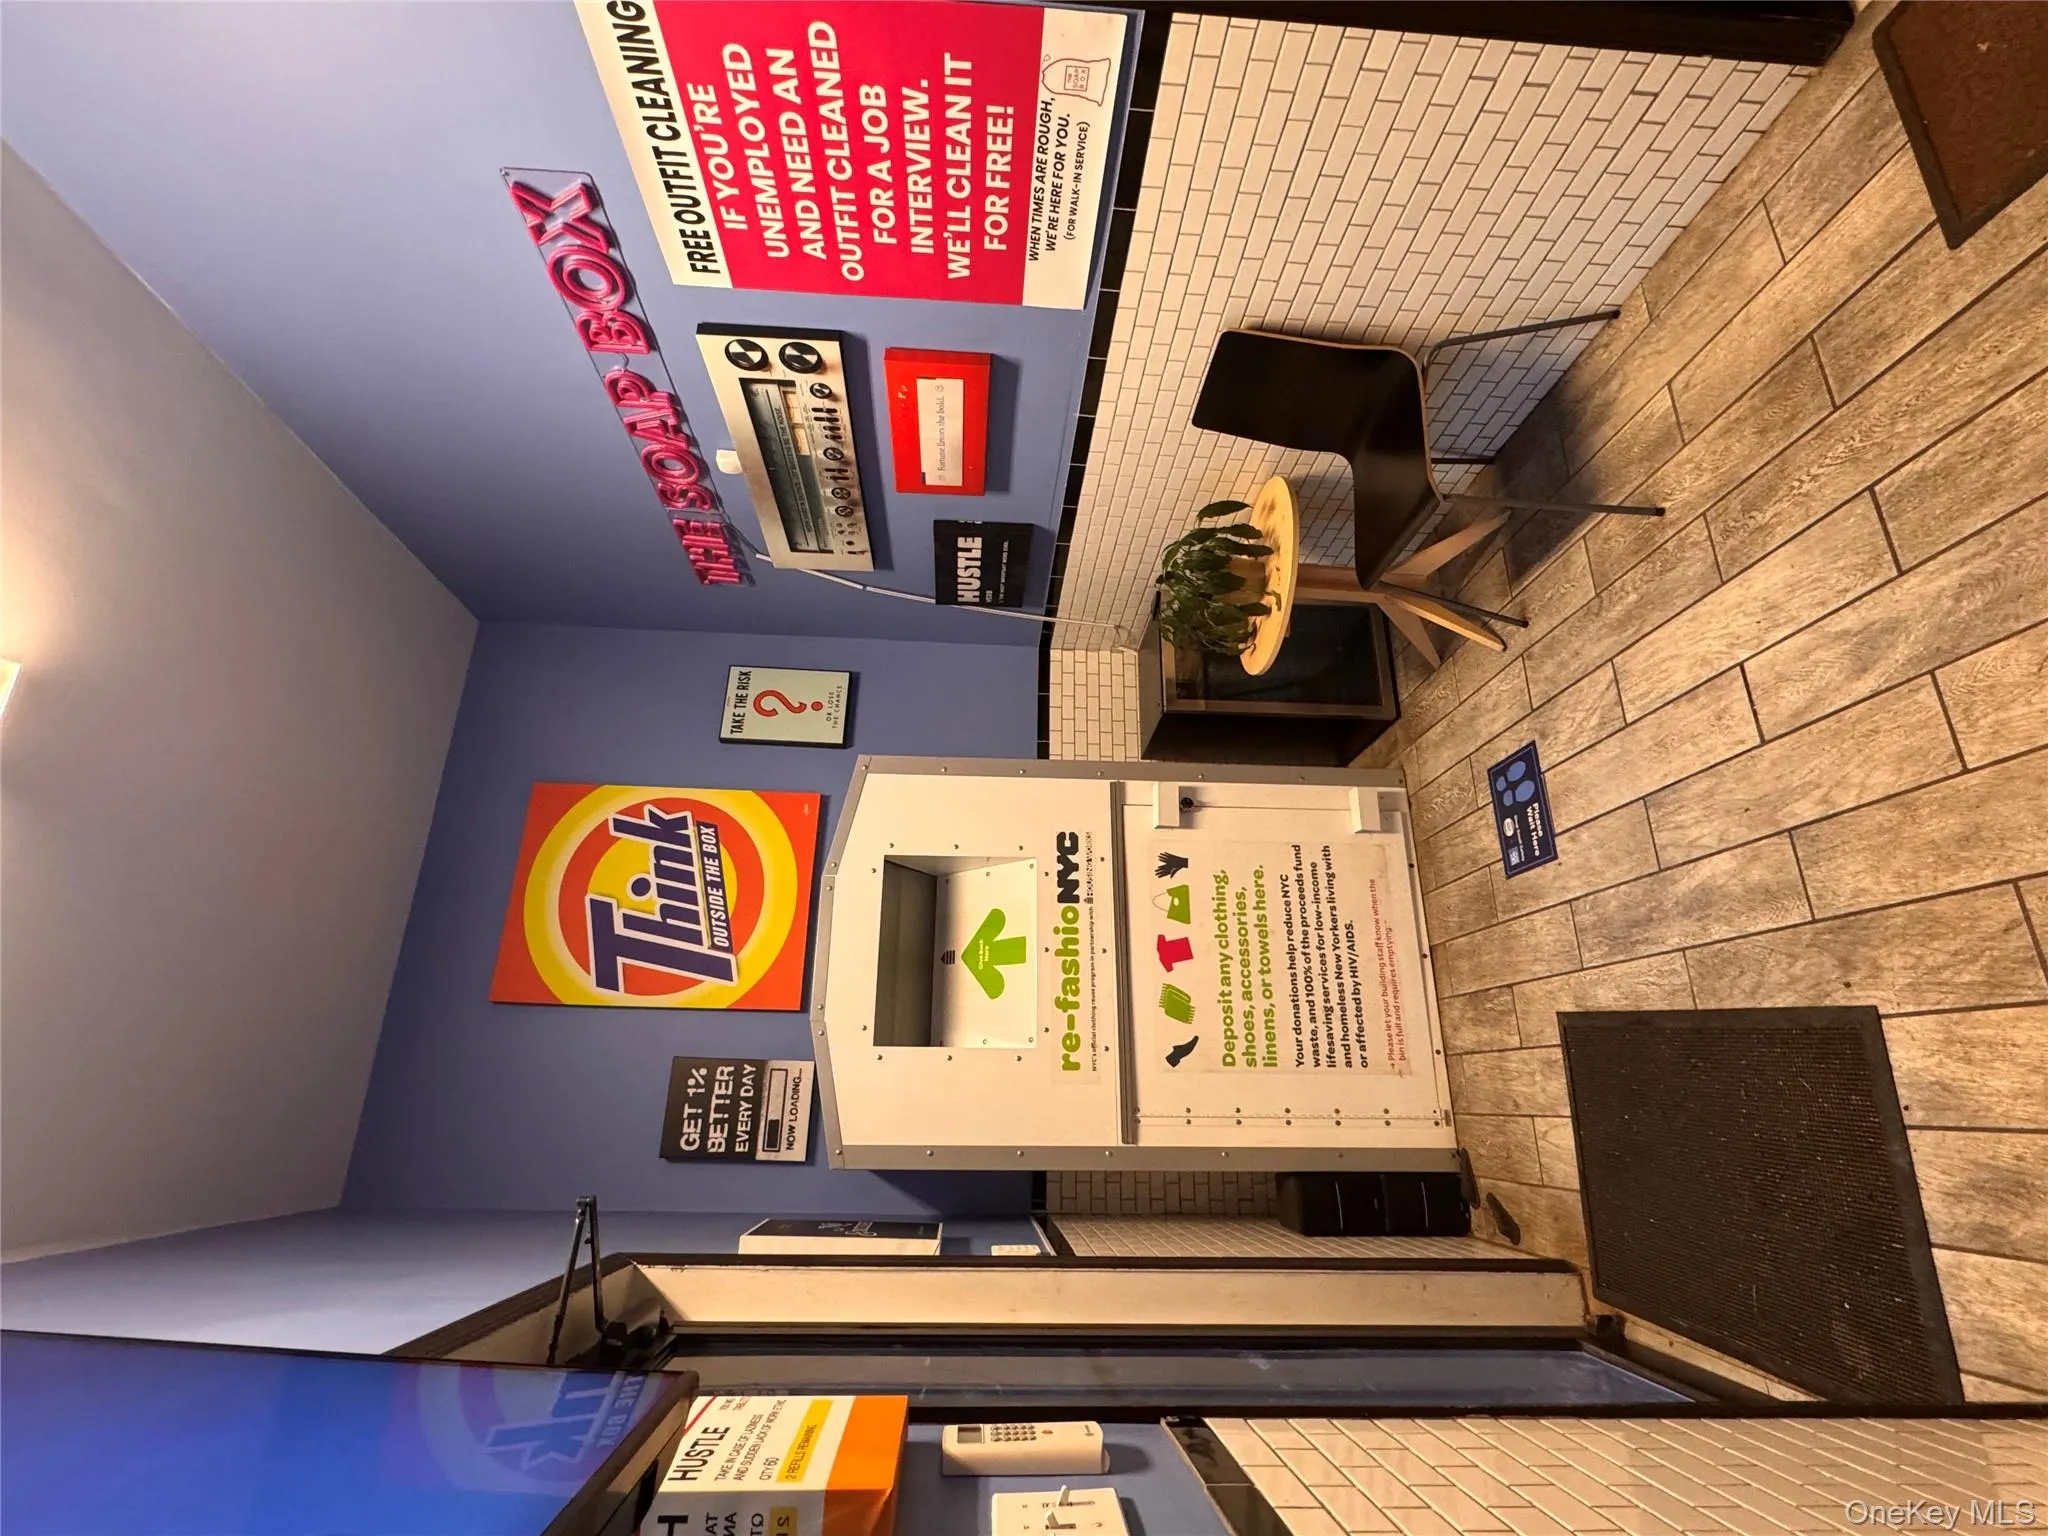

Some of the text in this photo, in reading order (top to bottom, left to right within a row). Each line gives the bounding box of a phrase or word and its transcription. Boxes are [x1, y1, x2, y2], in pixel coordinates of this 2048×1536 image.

[944, 52, 973, 86] IT
[605, 0, 721, 274] FREE OUTFIT CLEANING
[722, 43, 790, 258] UNEMPLOYED
[766, 48, 827, 260] AND NEED AN
[807, 21, 865, 282] OUTFIT CLEANED
[859, 85, 897, 245] FOR A JOB
[902, 79, 934, 254] INTERVIEW.
[945, 95, 973, 199] CLEAN
[1052, 151, 1067, 179] FOR
[1055, 113, 1071, 149] YOU.
[720, 206, 748, 230] IF
[984, 105, 1015, 251] FOR FREE!
[1028, 97, 1056, 261] WHEN TIMES ARE ROUGH,
[1049, 182, 1063, 214] HERE
[1064, 121, 1090, 240] (FOR WALK-IN SERVICE)
[509, 183, 742, 586] THE SOAP BOX
[935, 415, 944, 426] the
[957, 537, 982, 602] HUSTLE
[730, 670, 752, 735] TAKE THE RISK
[826, 712, 833, 722] OR
[834, 685, 842, 712] CHANCE
[1526, 806, 1540, 856] Wait Here
[1532, 802, 1543, 837] Please
[586, 806, 736, 994] Think
[699, 825, 730, 947] OUTSIDE THE BOX
[1053, 831, 1081, 1072] re-fashioNYC
[1212, 870, 1238, 1067] Deposit any clothing,
[1233, 886, 1257, 1068] shoes, accessories,
[1251, 865, 1278, 1068] linens, or towels here.
[1280, 874, 1305, 1067] Your donations help reduce NYC
[1291, 844, 1321, 1068] waste, and 100% of the proceeds fund
[1309, 862, 1337, 1068] lifesaving services for low-income
[1321, 845, 1352, 1068] and homeless New Yorkers living with
[1369, 879, 1395, 1061] Please let your building staff know when the
[1385, 928, 1396, 967] emptying
[1390, 969, 1400, 1004] requires
[1344, 920, 1369, 1068] or affected by HIV/AIDS.
[1392, 1005, 1401, 1021] and
[1394, 1023, 1404, 1037] full
[1398, 1047, 1406, 1061] bin
[679, 1068, 708, 1151] GET 1%
[707, 1066, 735, 1152] BETTER
[735, 1064, 756, 1152] EVERY DAY
[786, 1068, 802, 1150] NOW LOADING...
[667, 1427, 730, 1480] HUSTLE
[714, 1465, 733, 1480] TAKE
[729, 1443, 746, 1456] CASE
[733, 1467, 749, 1480] AND
[741, 1444, 760, 1466] SUDDEN
[754, 1431, 769, 1443] LACK
[759, 1457, 779, 1480] QTY 60
[786, 1451, 806, 1473] REFILLS
